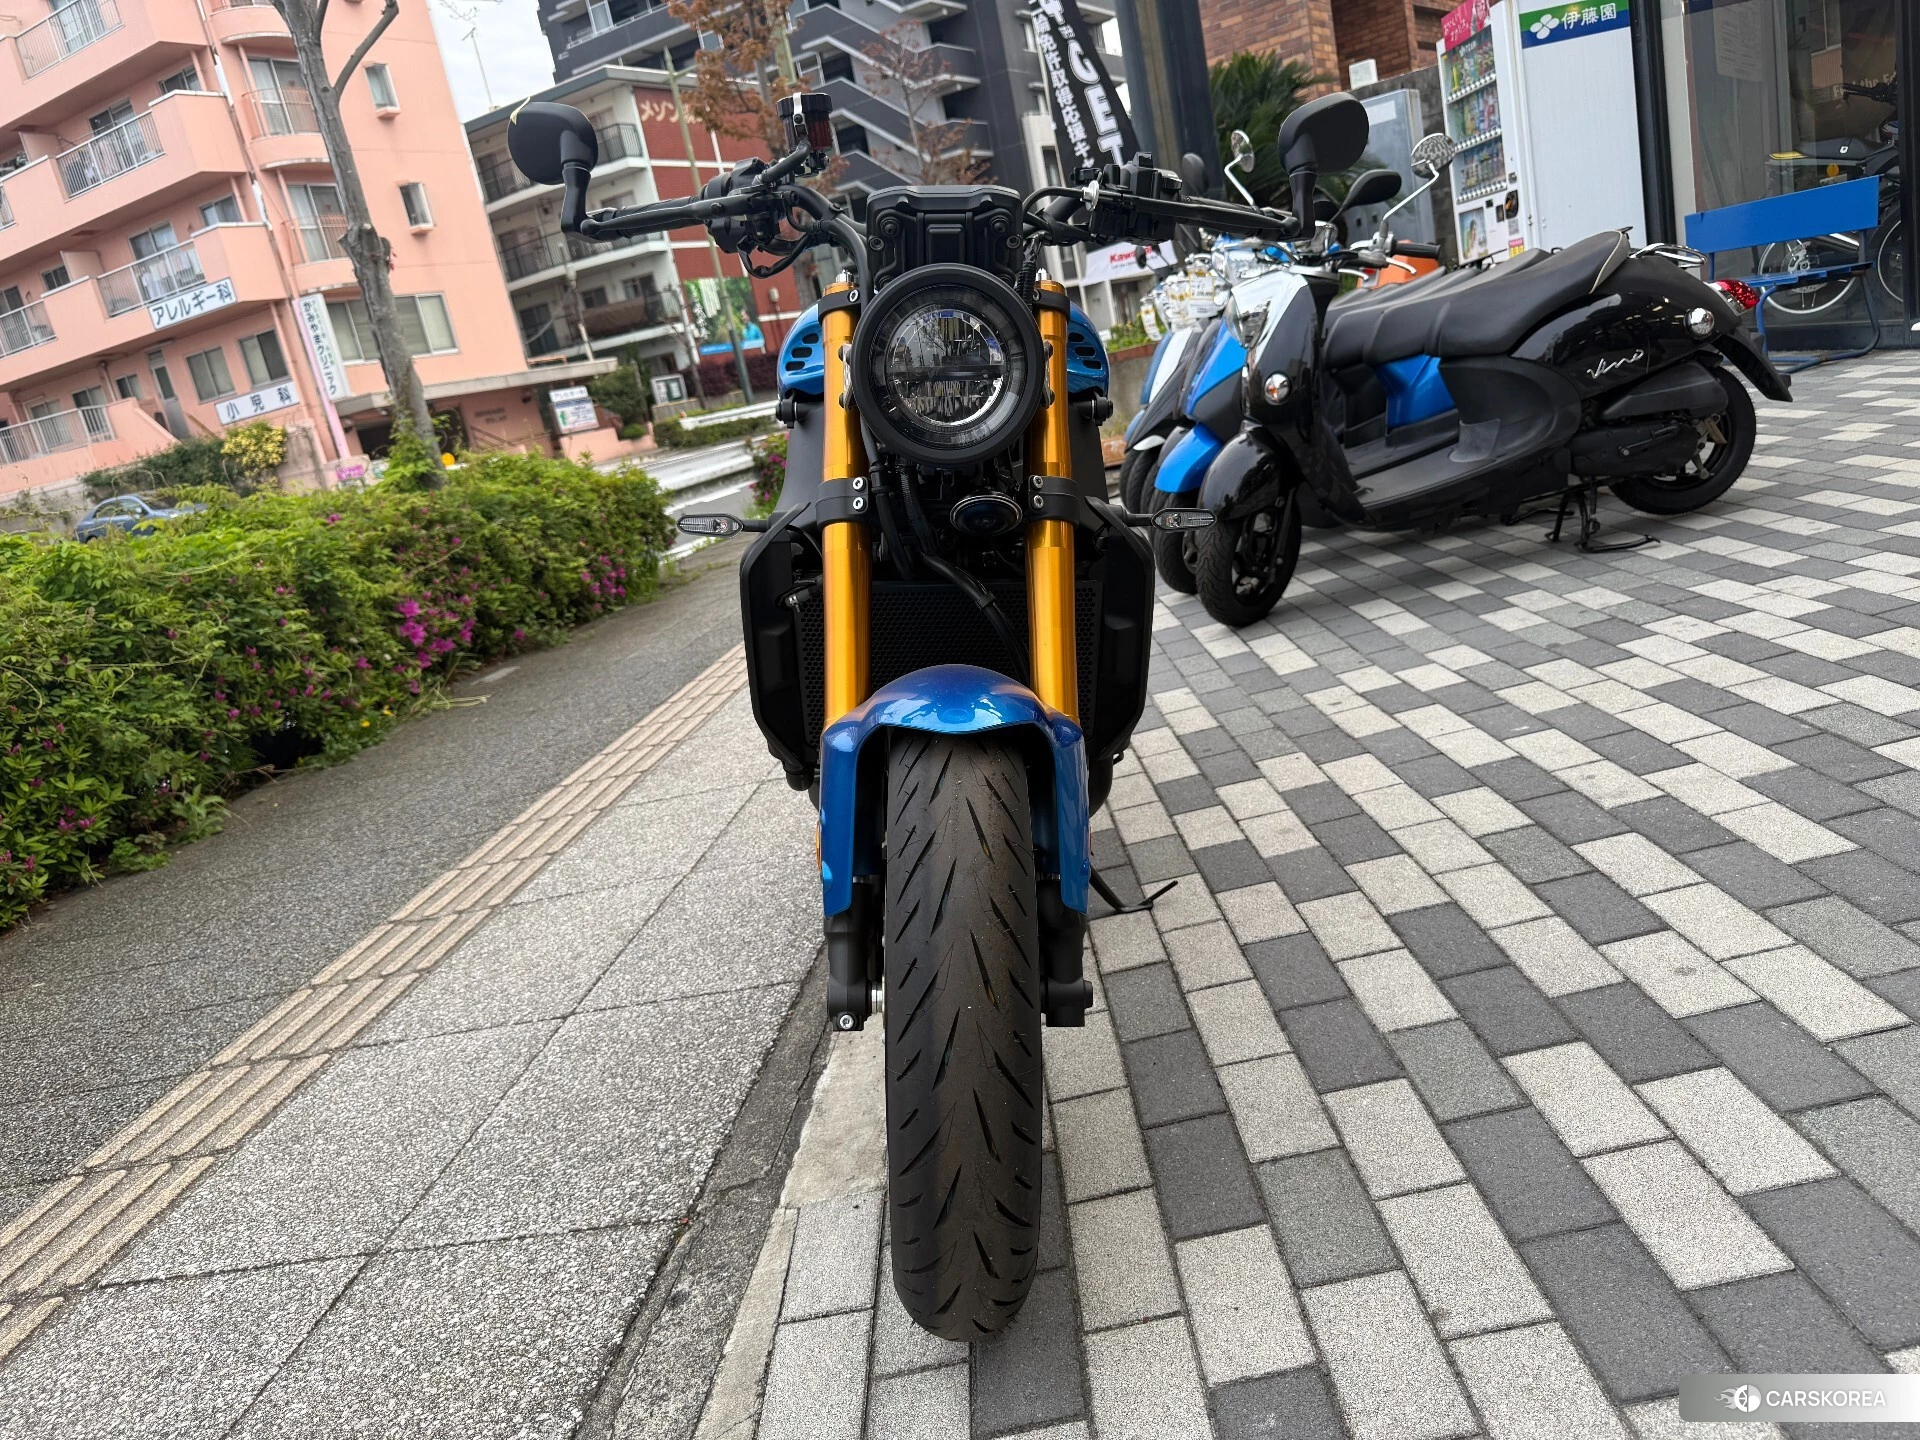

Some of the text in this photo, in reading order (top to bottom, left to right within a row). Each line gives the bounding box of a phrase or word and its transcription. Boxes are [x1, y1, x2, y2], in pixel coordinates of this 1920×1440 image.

[1561, 2, 1617, 30] 伊藤園
[152, 281, 233, 326] アレルギー科
[1586, 348, 1644, 379] Vino
[226, 385, 292, 420] 小児科
